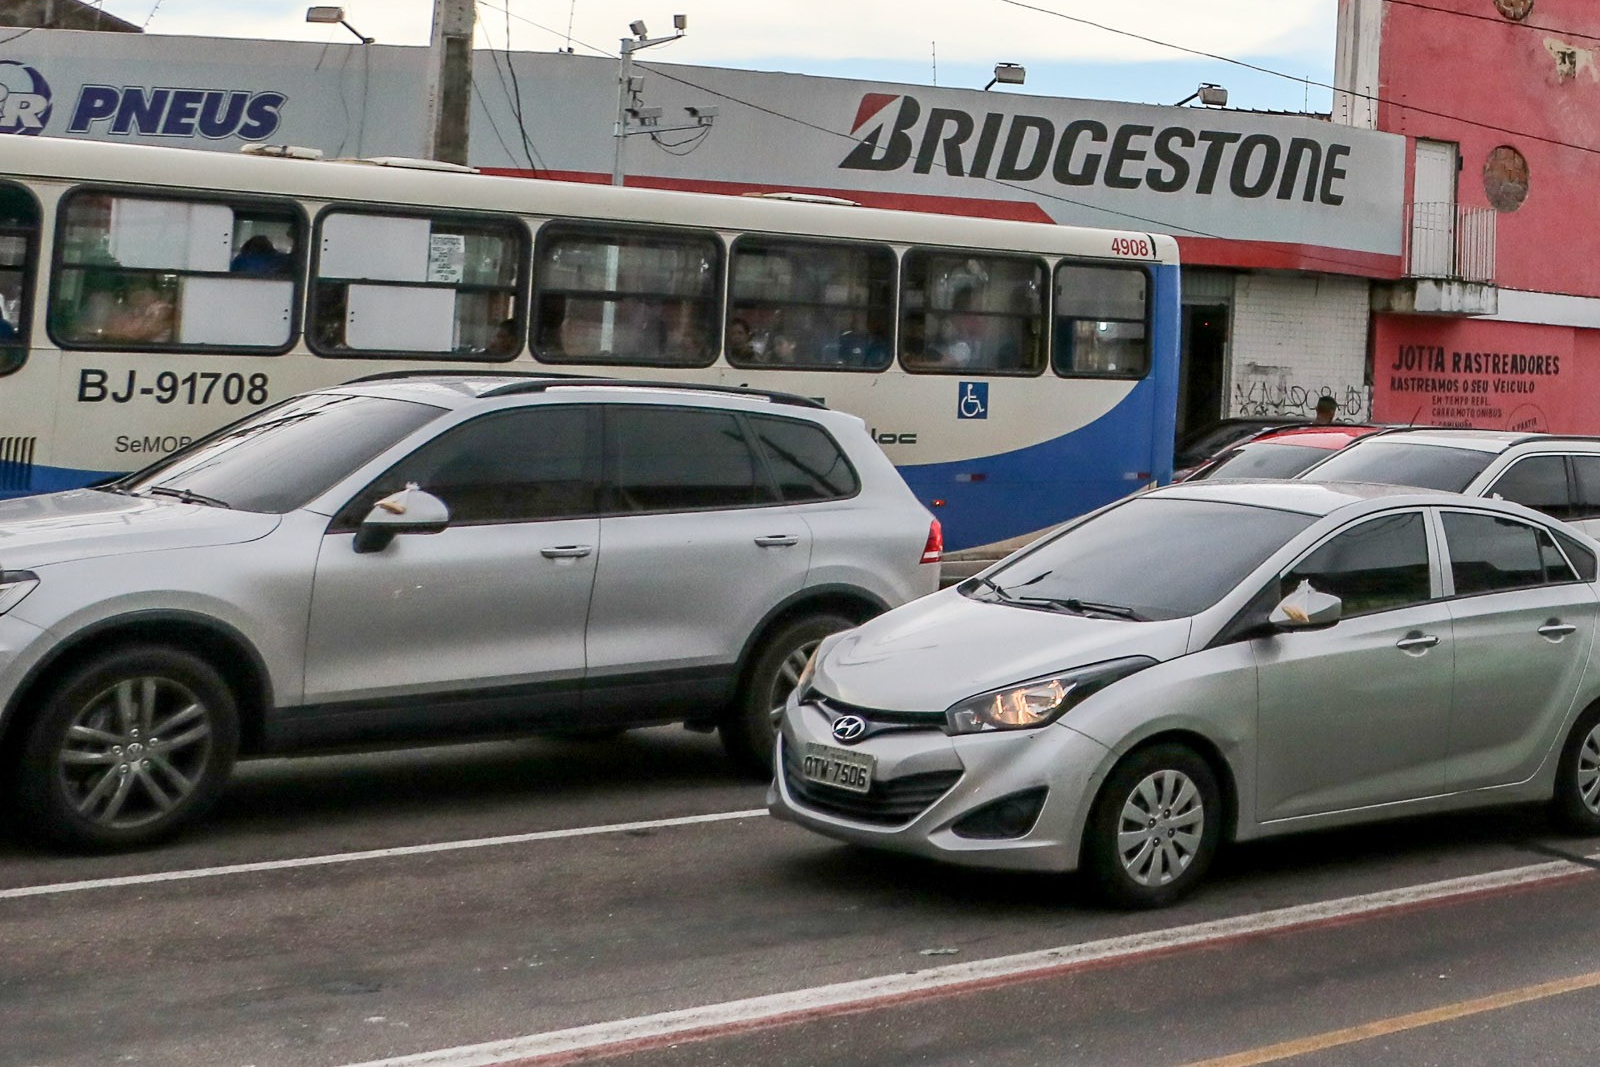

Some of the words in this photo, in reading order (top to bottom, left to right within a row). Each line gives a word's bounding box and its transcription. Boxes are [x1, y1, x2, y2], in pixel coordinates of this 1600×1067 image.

[67, 84, 288, 141] PNEUS
[839, 93, 1351, 206] BRIDGESTONE
[1111, 237, 1149, 256] 4908
[1392, 345, 1446, 373] JOTTA
[1452, 352, 1560, 376] RASTREADORES
[78, 369, 269, 405] BJ-91708
[1390, 377, 1459, 393] RASTREAMOS
[1462, 379, 1469, 393] O
[1471, 379, 1489, 393] SEU
[1493, 378, 1535, 394] VEICULO
[1445, 396, 1469, 406] TEMPO
